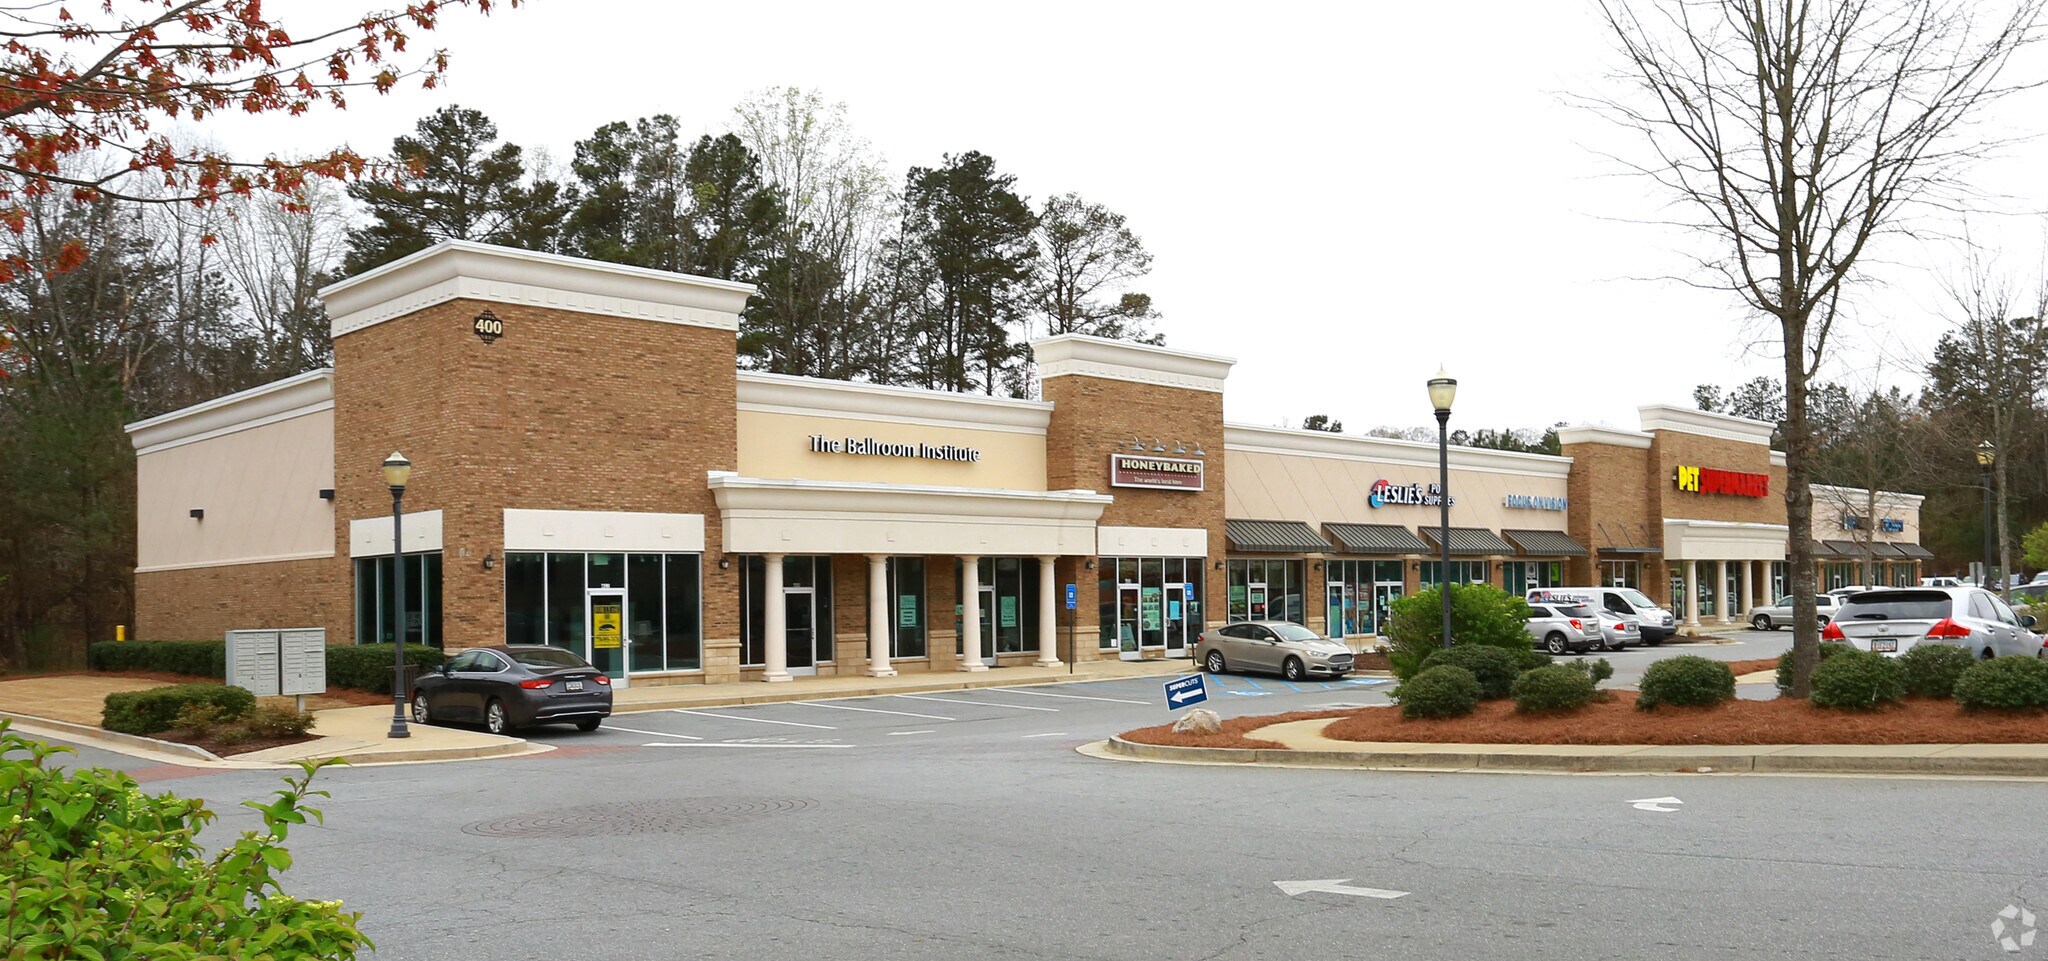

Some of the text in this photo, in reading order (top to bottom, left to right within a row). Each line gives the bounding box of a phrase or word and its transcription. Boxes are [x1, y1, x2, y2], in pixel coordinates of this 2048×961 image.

[475, 319, 503, 335] 400
[810, 435, 982, 462] The Ballroom Institute
[1121, 459, 1201, 473] HONEYBAKED
[1678, 465, 1700, 492] PET
[1377, 483, 1423, 504] LESLIE'S
[1424, 495, 1456, 507] SUPPES
[1506, 494, 1568, 510] FOCUS ON VISION
[1169, 678, 1199, 692] SUPERCUTS
